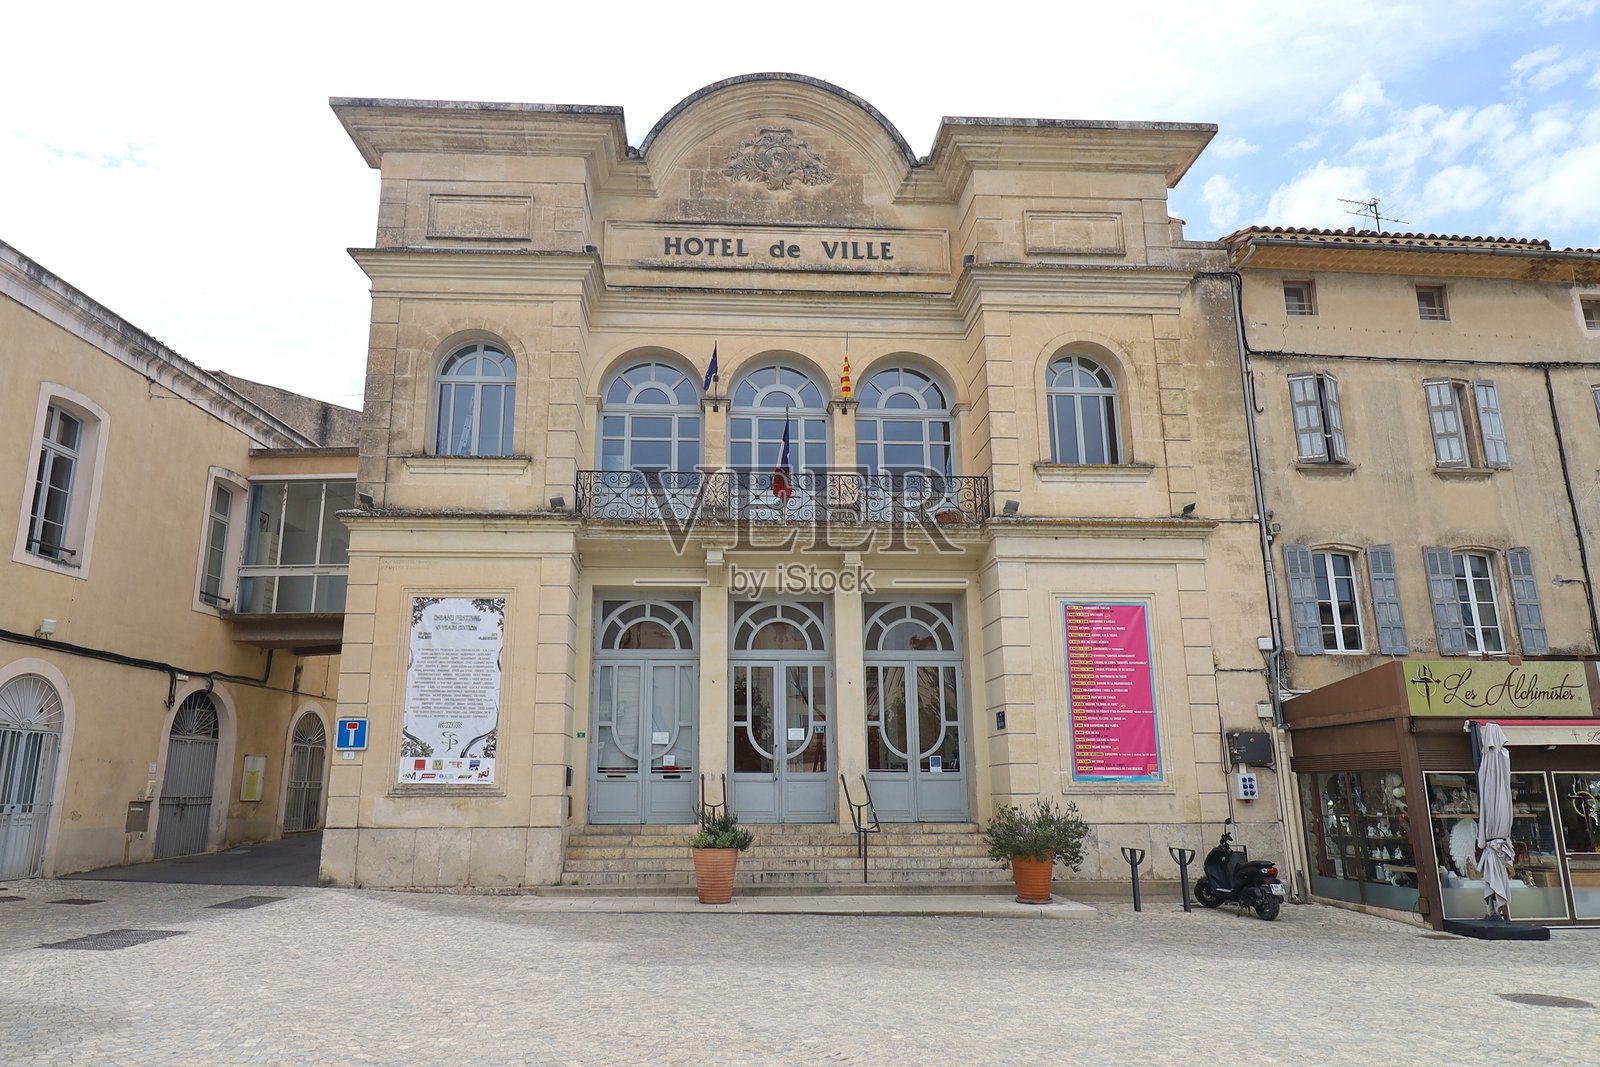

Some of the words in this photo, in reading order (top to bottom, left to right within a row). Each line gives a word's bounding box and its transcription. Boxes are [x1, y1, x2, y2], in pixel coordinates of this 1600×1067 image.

[664, 237, 748, 257] HOTEL
[769, 240, 800, 258] de
[821, 241, 893, 260] VILLE
[1443, 668, 1486, 708] Les
[1485, 667, 1584, 709] Alchimistes
